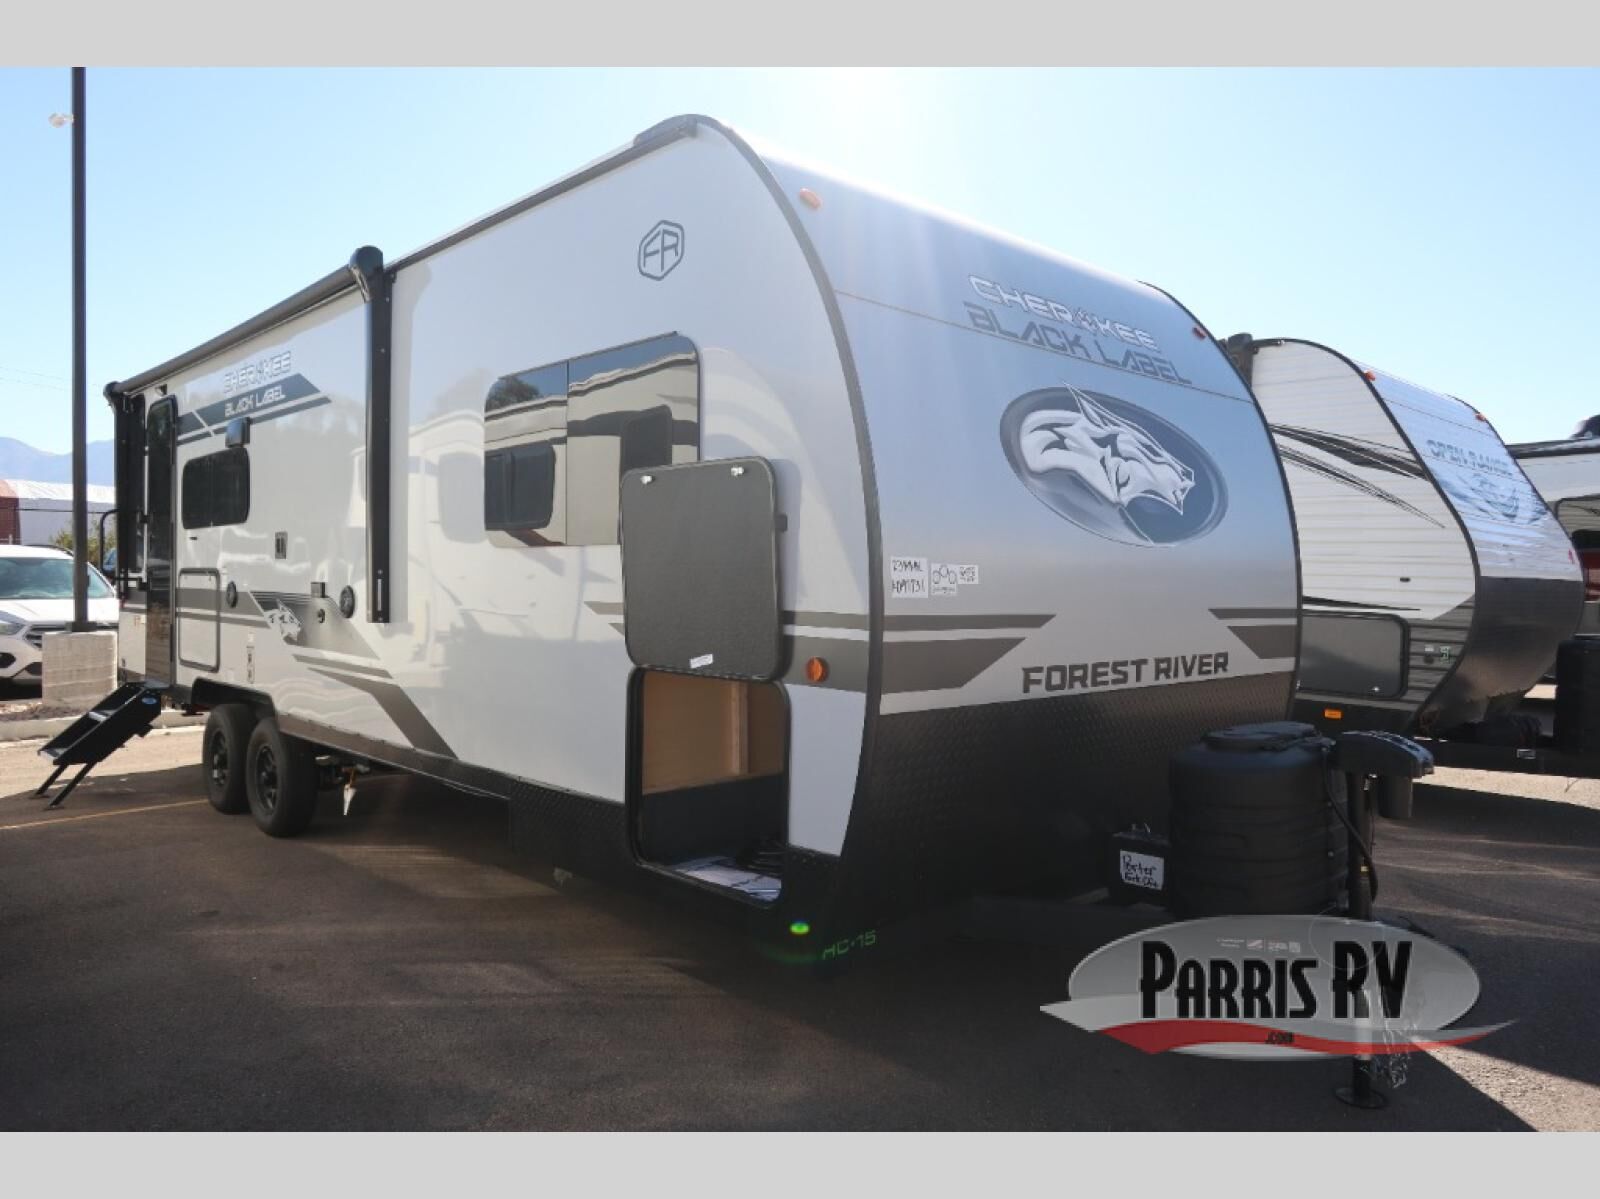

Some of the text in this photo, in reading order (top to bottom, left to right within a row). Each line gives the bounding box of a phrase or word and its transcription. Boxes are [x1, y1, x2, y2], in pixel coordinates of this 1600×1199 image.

[963, 301, 1193, 385] BLACK LABEL
[224, 384, 287, 417] BLACK LABEL
[1021, 651, 1229, 694] FOREST RIVER
